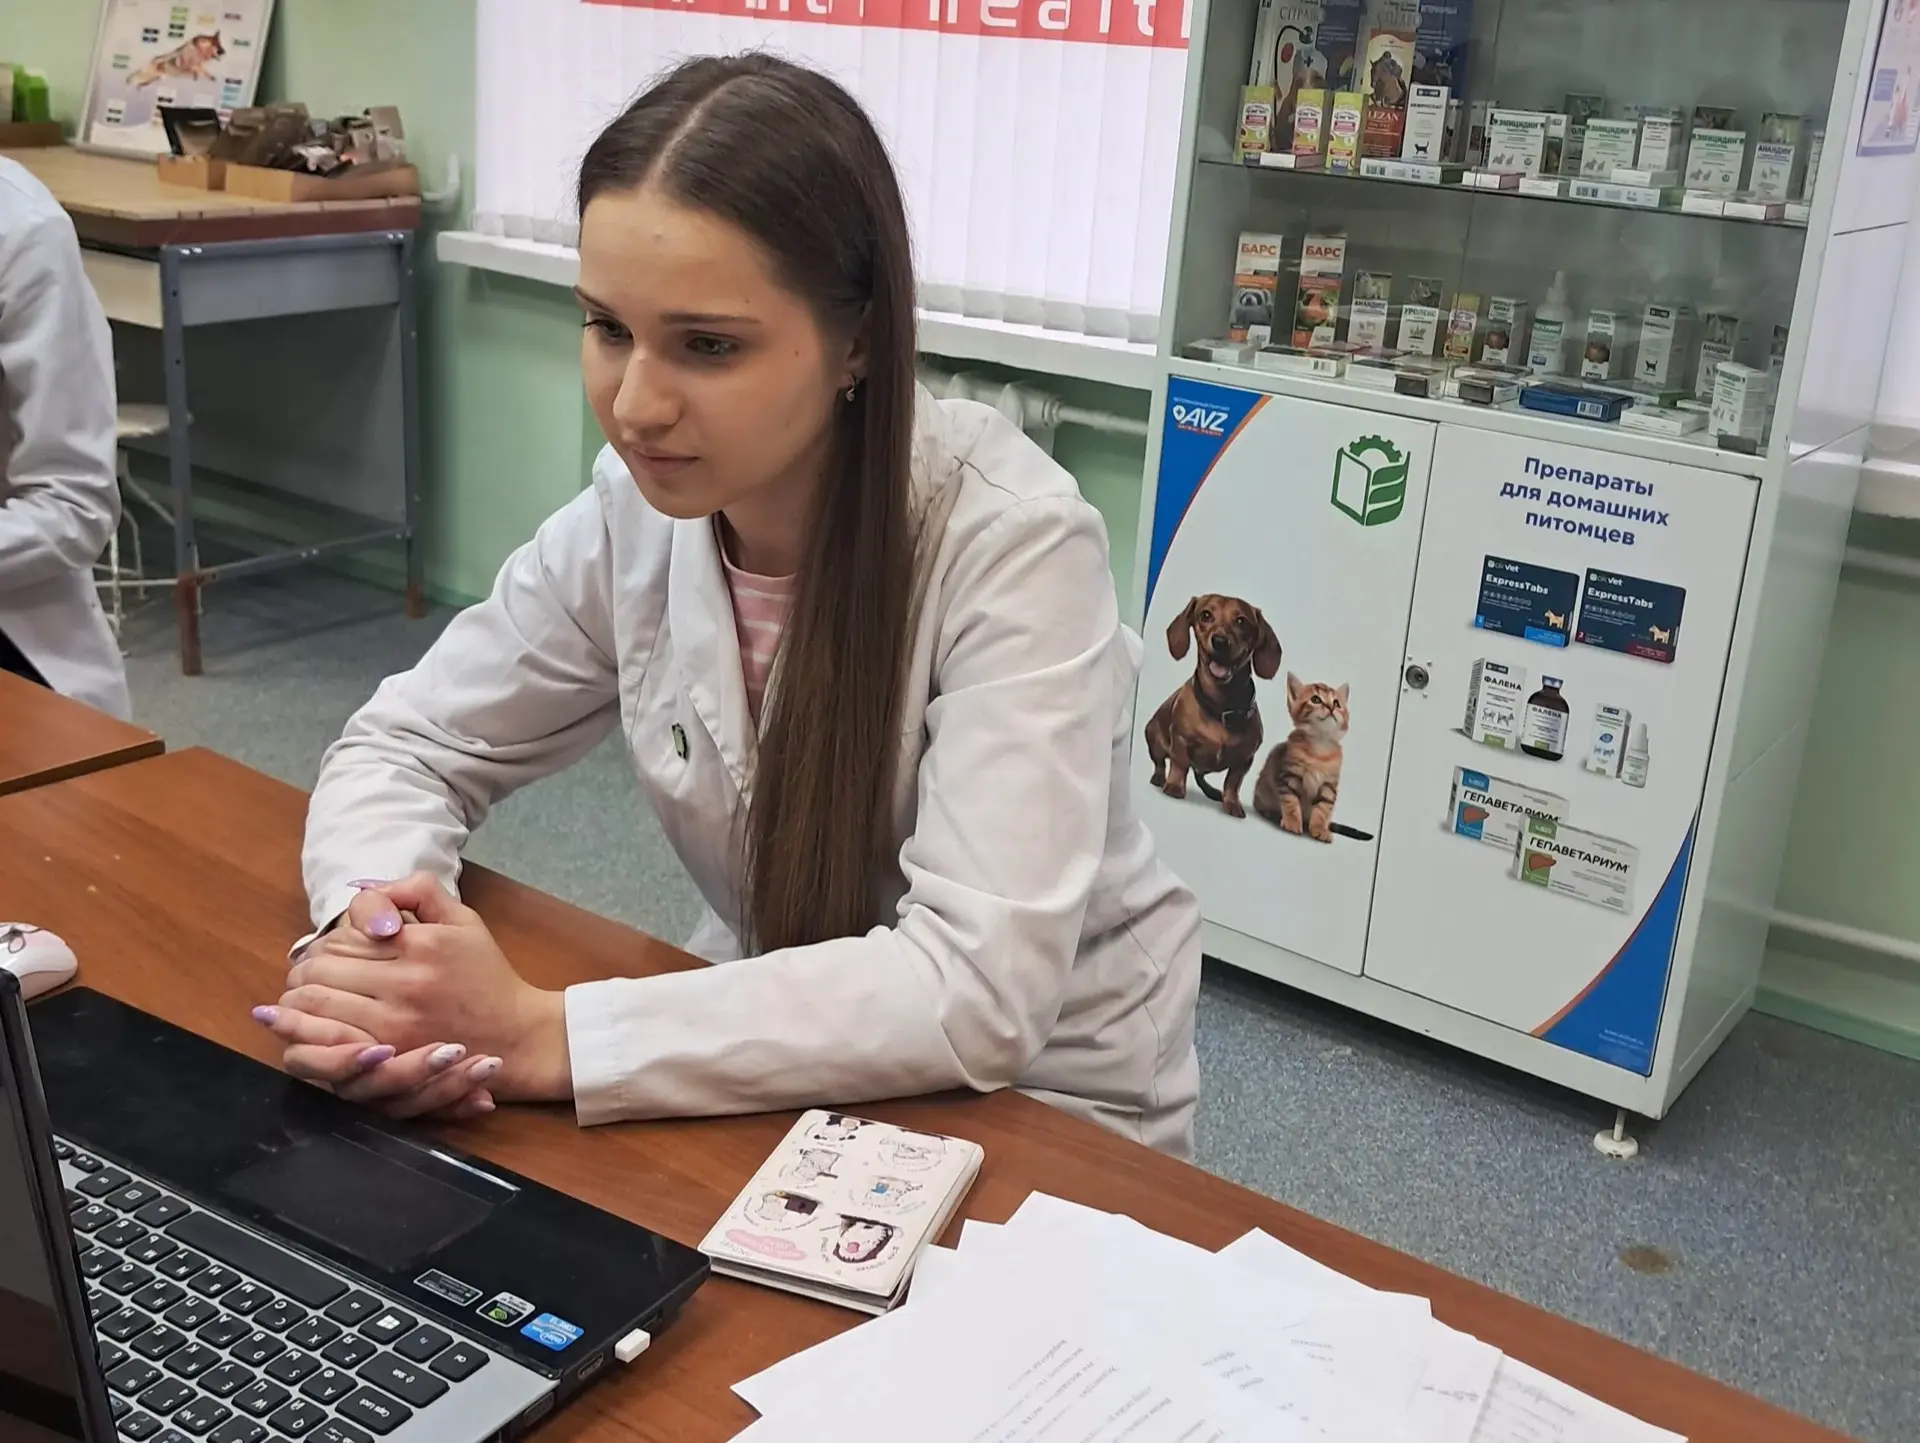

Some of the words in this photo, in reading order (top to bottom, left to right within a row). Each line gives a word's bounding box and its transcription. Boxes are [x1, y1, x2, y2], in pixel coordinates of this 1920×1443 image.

[1240, 242, 1277, 256] БАРС
[1305, 244, 1342, 258] БАРС
[1180, 407, 1228, 432] AVZ
[1524, 456, 1654, 497] Препараты
[1499, 481, 1542, 501] для
[1546, 491, 1670, 526] домашних
[1525, 511, 1636, 546] питомцев
[1485, 573, 1549, 595] ExpressTabs
[1587, 587, 1654, 609] ExpressTabs
[1484, 675, 1522, 692] ФАЛЕНА
[1531, 706, 1562, 720] ФАЛЕНА
[1463, 789, 1559, 822] ГЕПАВЕТАРИУМ
[1529, 836, 1629, 874] ГЕПАВЕТАРИУМ
